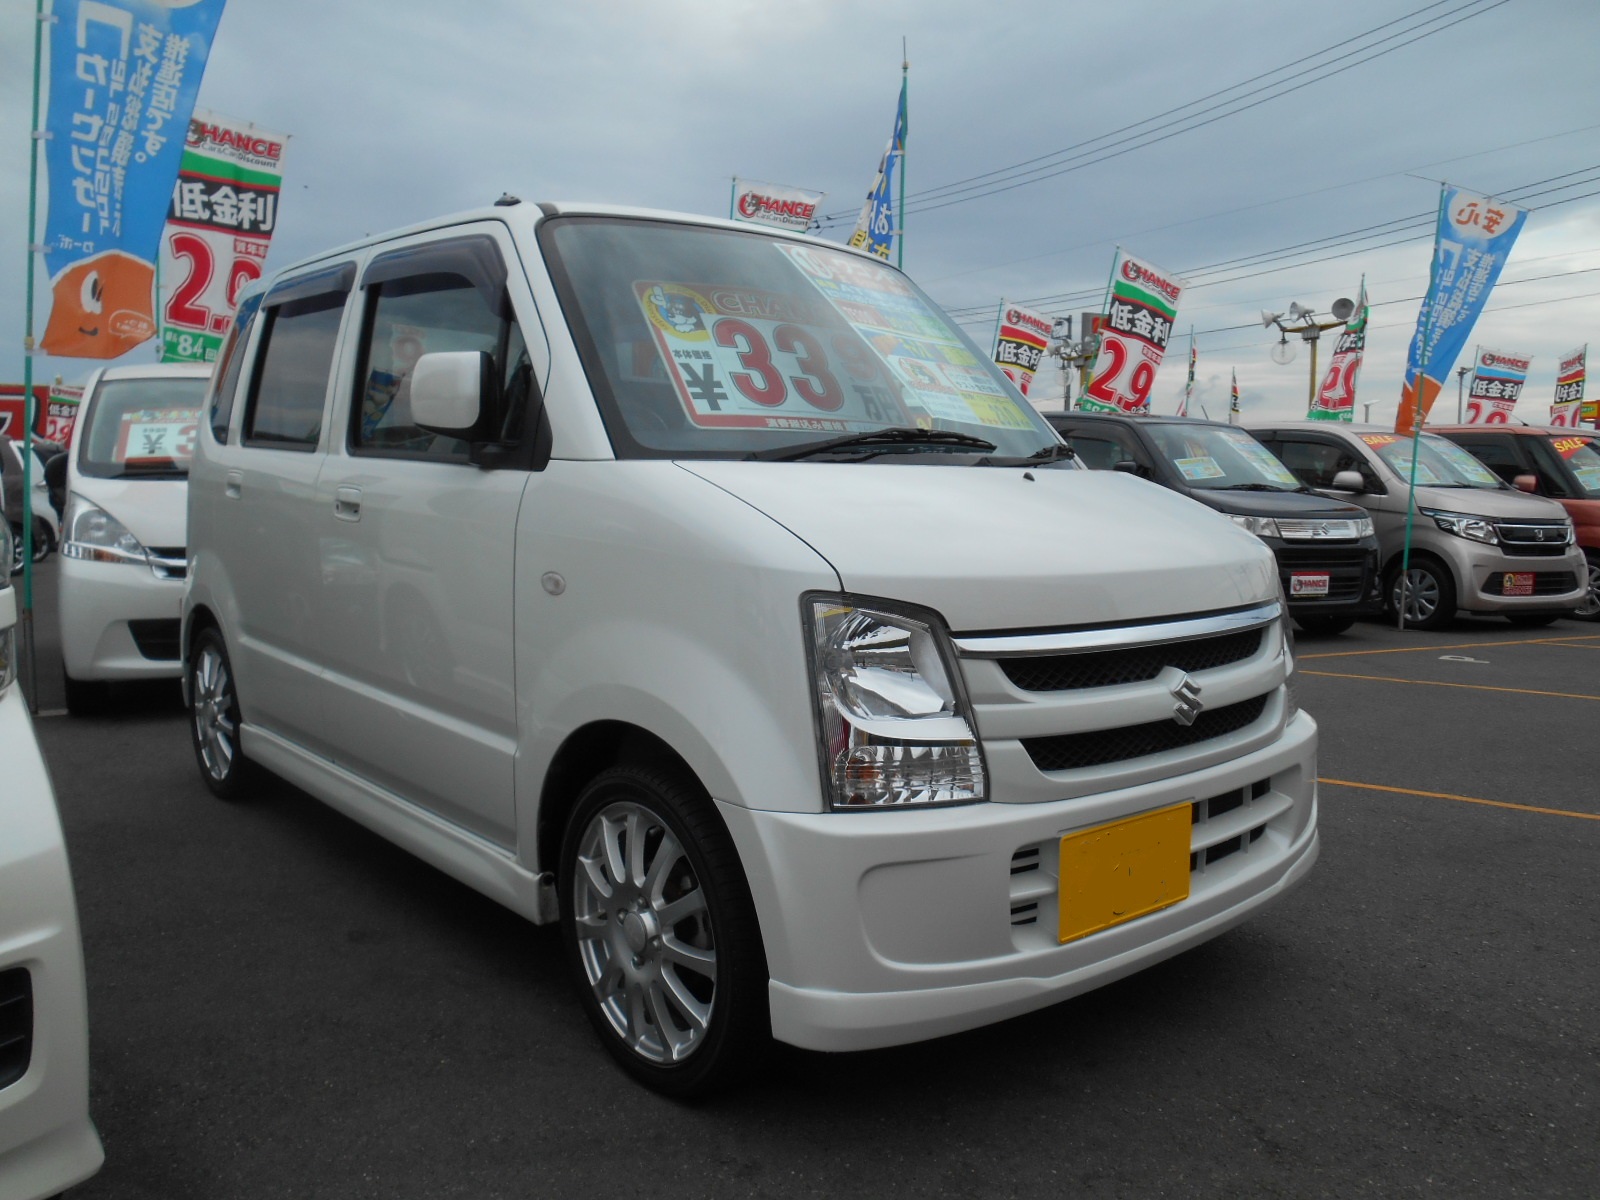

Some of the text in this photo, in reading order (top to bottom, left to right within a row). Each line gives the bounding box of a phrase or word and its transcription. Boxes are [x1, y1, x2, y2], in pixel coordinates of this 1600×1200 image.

[173, 178, 275, 231] 低金利
[1110, 300, 1171, 347] 低金利
[1471, 379, 1522, 400] 低金利
[1362, 435, 1396, 445] SALE
[1553, 437, 1585, 453] SALE
